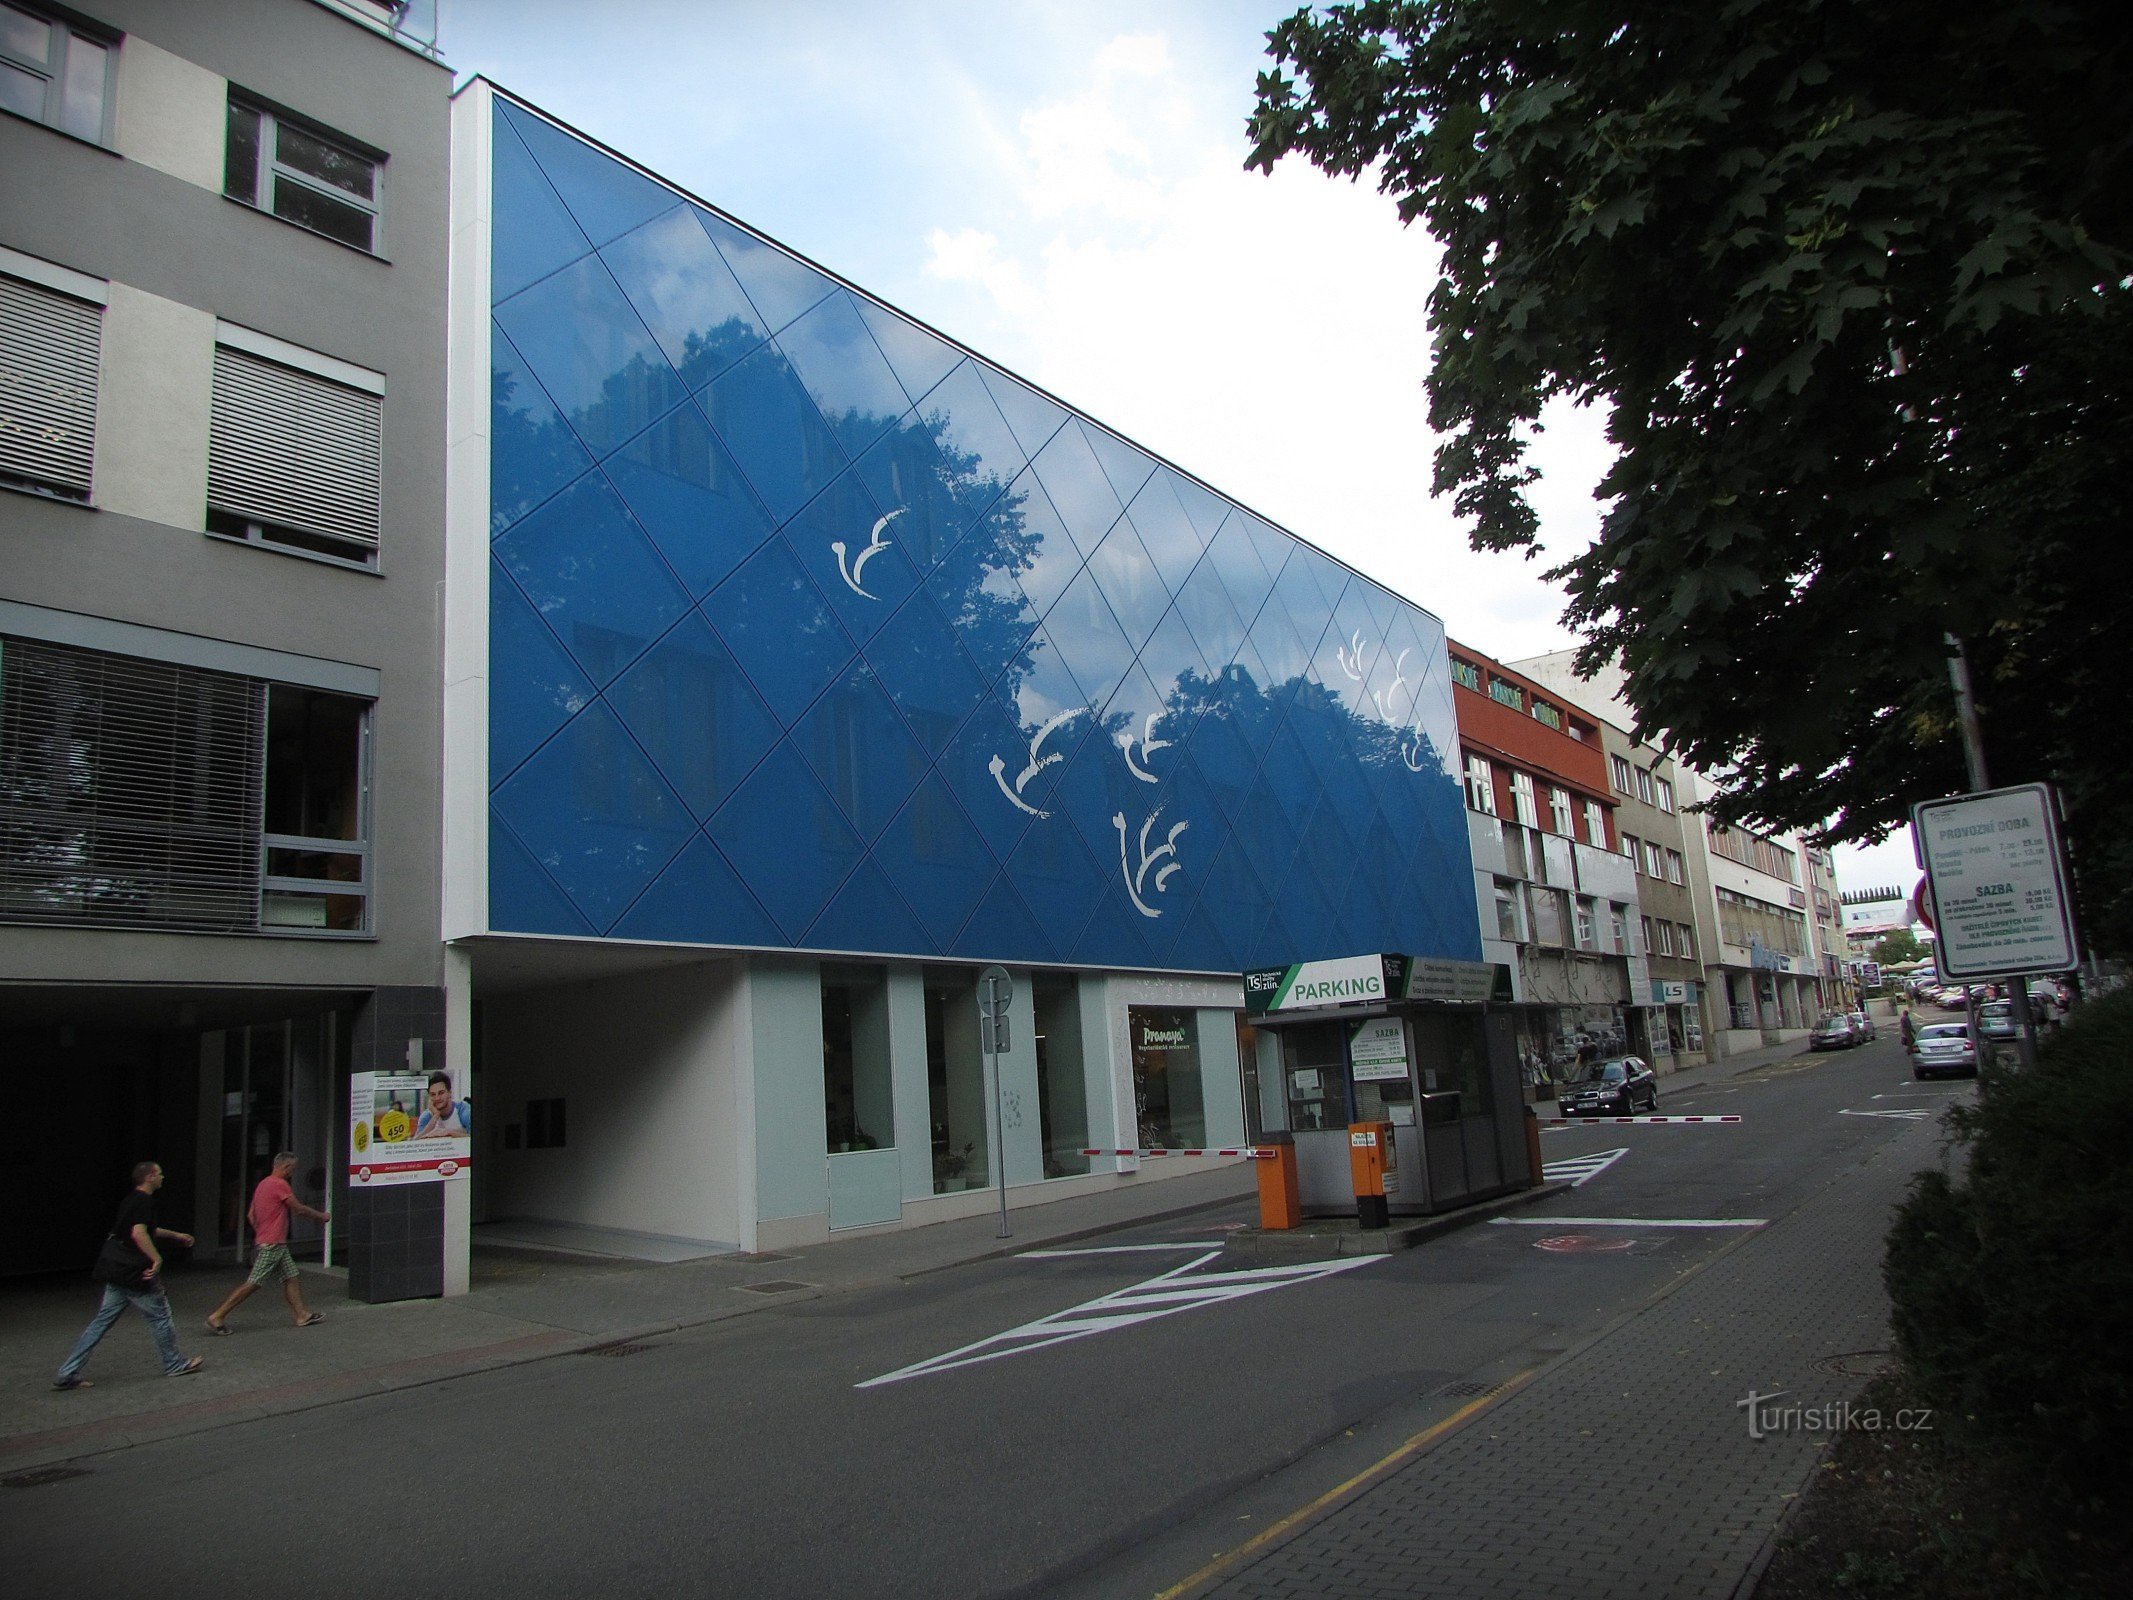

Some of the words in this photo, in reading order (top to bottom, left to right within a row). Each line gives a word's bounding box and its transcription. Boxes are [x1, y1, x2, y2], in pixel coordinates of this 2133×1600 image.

[1938, 820, 1994, 840] PROVOZNÍ
[1997, 817, 2030, 831] DOBA
[1975, 882, 2013, 897] SAZBA
[1295, 976, 1380, 1000] PARKING
[1376, 1028, 1399, 1038] SAZBA
[388, 1125, 404, 1138] 450
